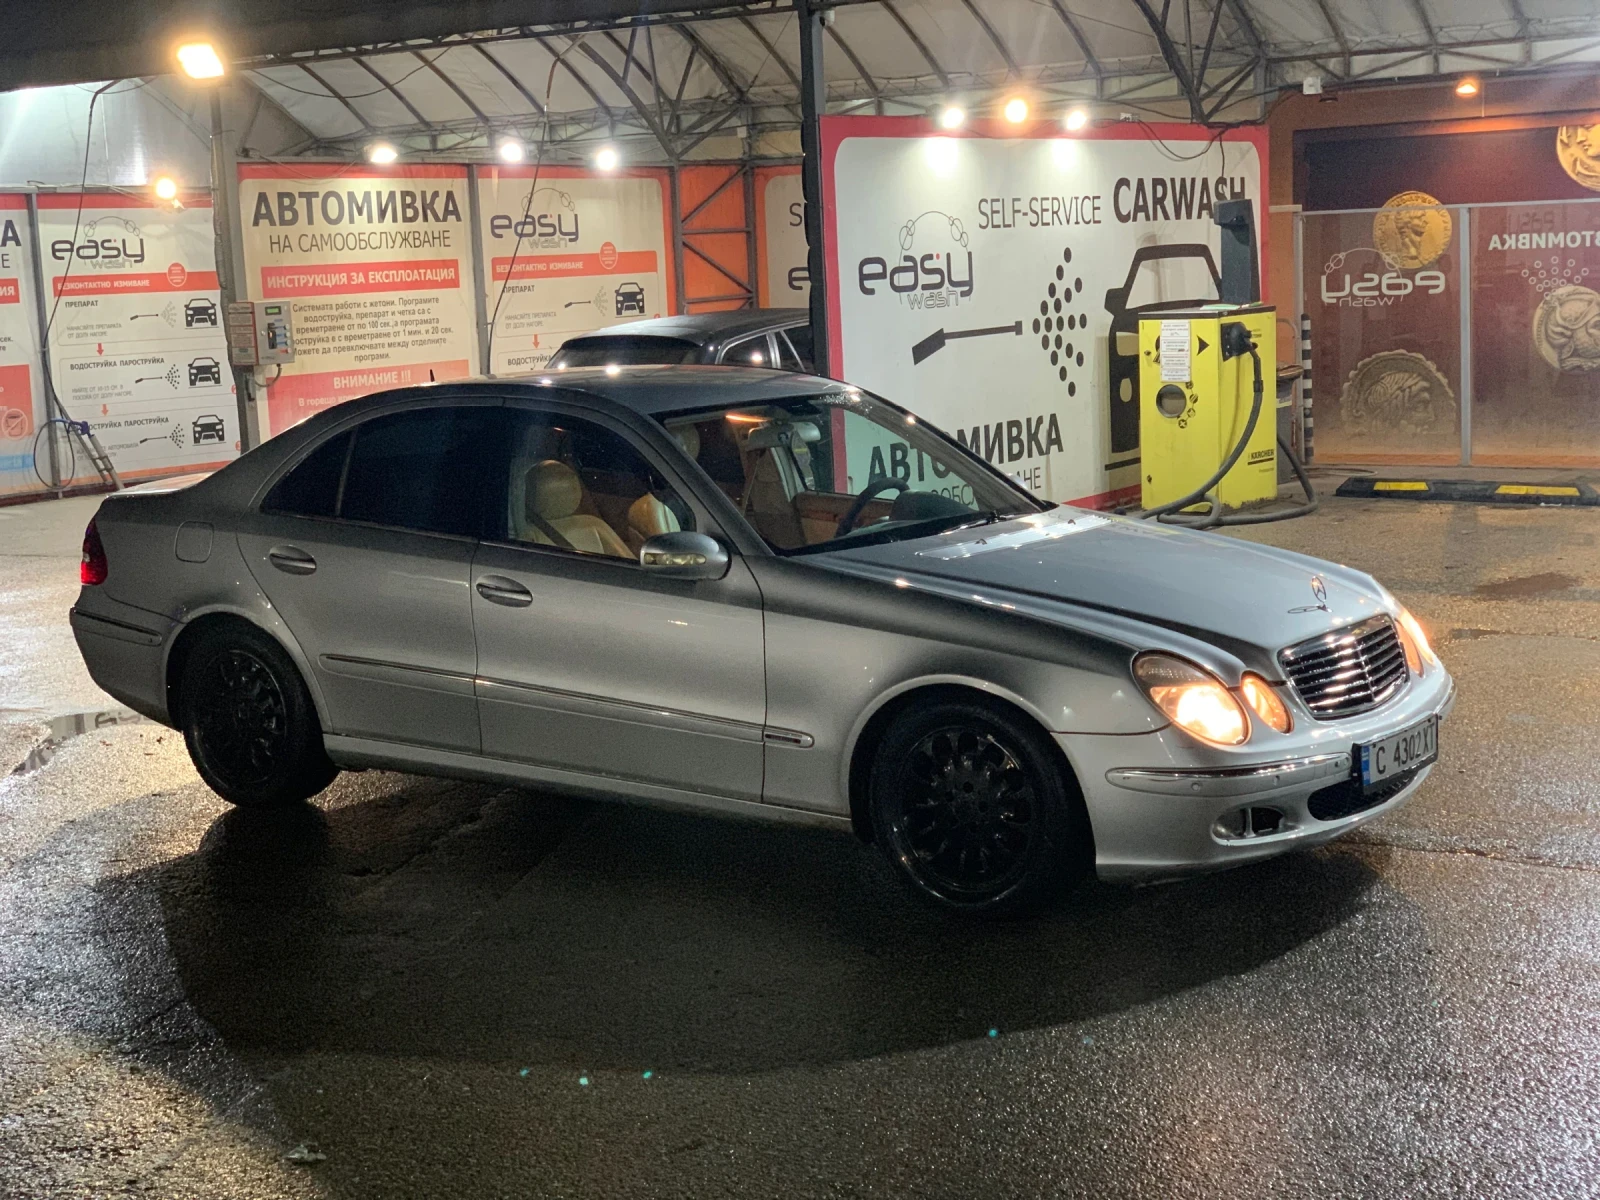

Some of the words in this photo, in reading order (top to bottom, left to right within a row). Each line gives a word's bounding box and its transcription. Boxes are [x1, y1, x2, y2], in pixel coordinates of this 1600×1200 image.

[252, 190, 462, 227] АВТОМИВКА
[978, 196, 1102, 229] SELF-SERVICE
[490, 214, 579, 242] easy
[269, 234, 293, 253] НА
[297, 230, 451, 253] САМООБСЛУЖВАНЕ
[528, 236, 567, 249] wash
[51, 238, 145, 263] easy
[90, 257, 133, 269] wash
[496, 263, 546, 273] БЕЗОНТАКТНО
[267, 273, 348, 289] ИНСТРУКЦИЯ
[350, 272, 365, 285] ЗА
[368, 268, 455, 284] ЕКСПЛОАТАЦИЯ
[858, 251, 973, 298] easy
[503, 285, 535, 293] ПРЕПАРАТ
[65, 300, 98, 308] ПРЕПАРАТ
[292, 303, 333, 313] Системата
[335, 301, 362, 312] работи
[398, 297, 440, 306] Програмите
[907, 287, 958, 310] wash
[355, 310, 389, 321] препарат
[397, 308, 416, 316] четка
[296, 324, 345, 335] времетраене
[347, 323, 355, 331] от
[357, 322, 366, 330] по
[368, 320, 378, 329] 100
[400, 318, 440, 327] програмата
[293, 335, 330, 346] оструйка
[344, 331, 391, 341] времетраене
[392, 330, 401, 338] от
[431, 326, 439, 334] 20
[321, 346, 331, 355] да
[333, 341, 386, 354] превключвате
[70, 360, 117, 371] ВОДОСТРУЙКА
[119, 357, 165, 367] ПАРОСТРУЙКА
[333, 371, 398, 389] ВНИМАНИЕ
[124, 416, 169, 427] ПАРОСТРУЙКА
[1376, 746, 1386, 775] C
